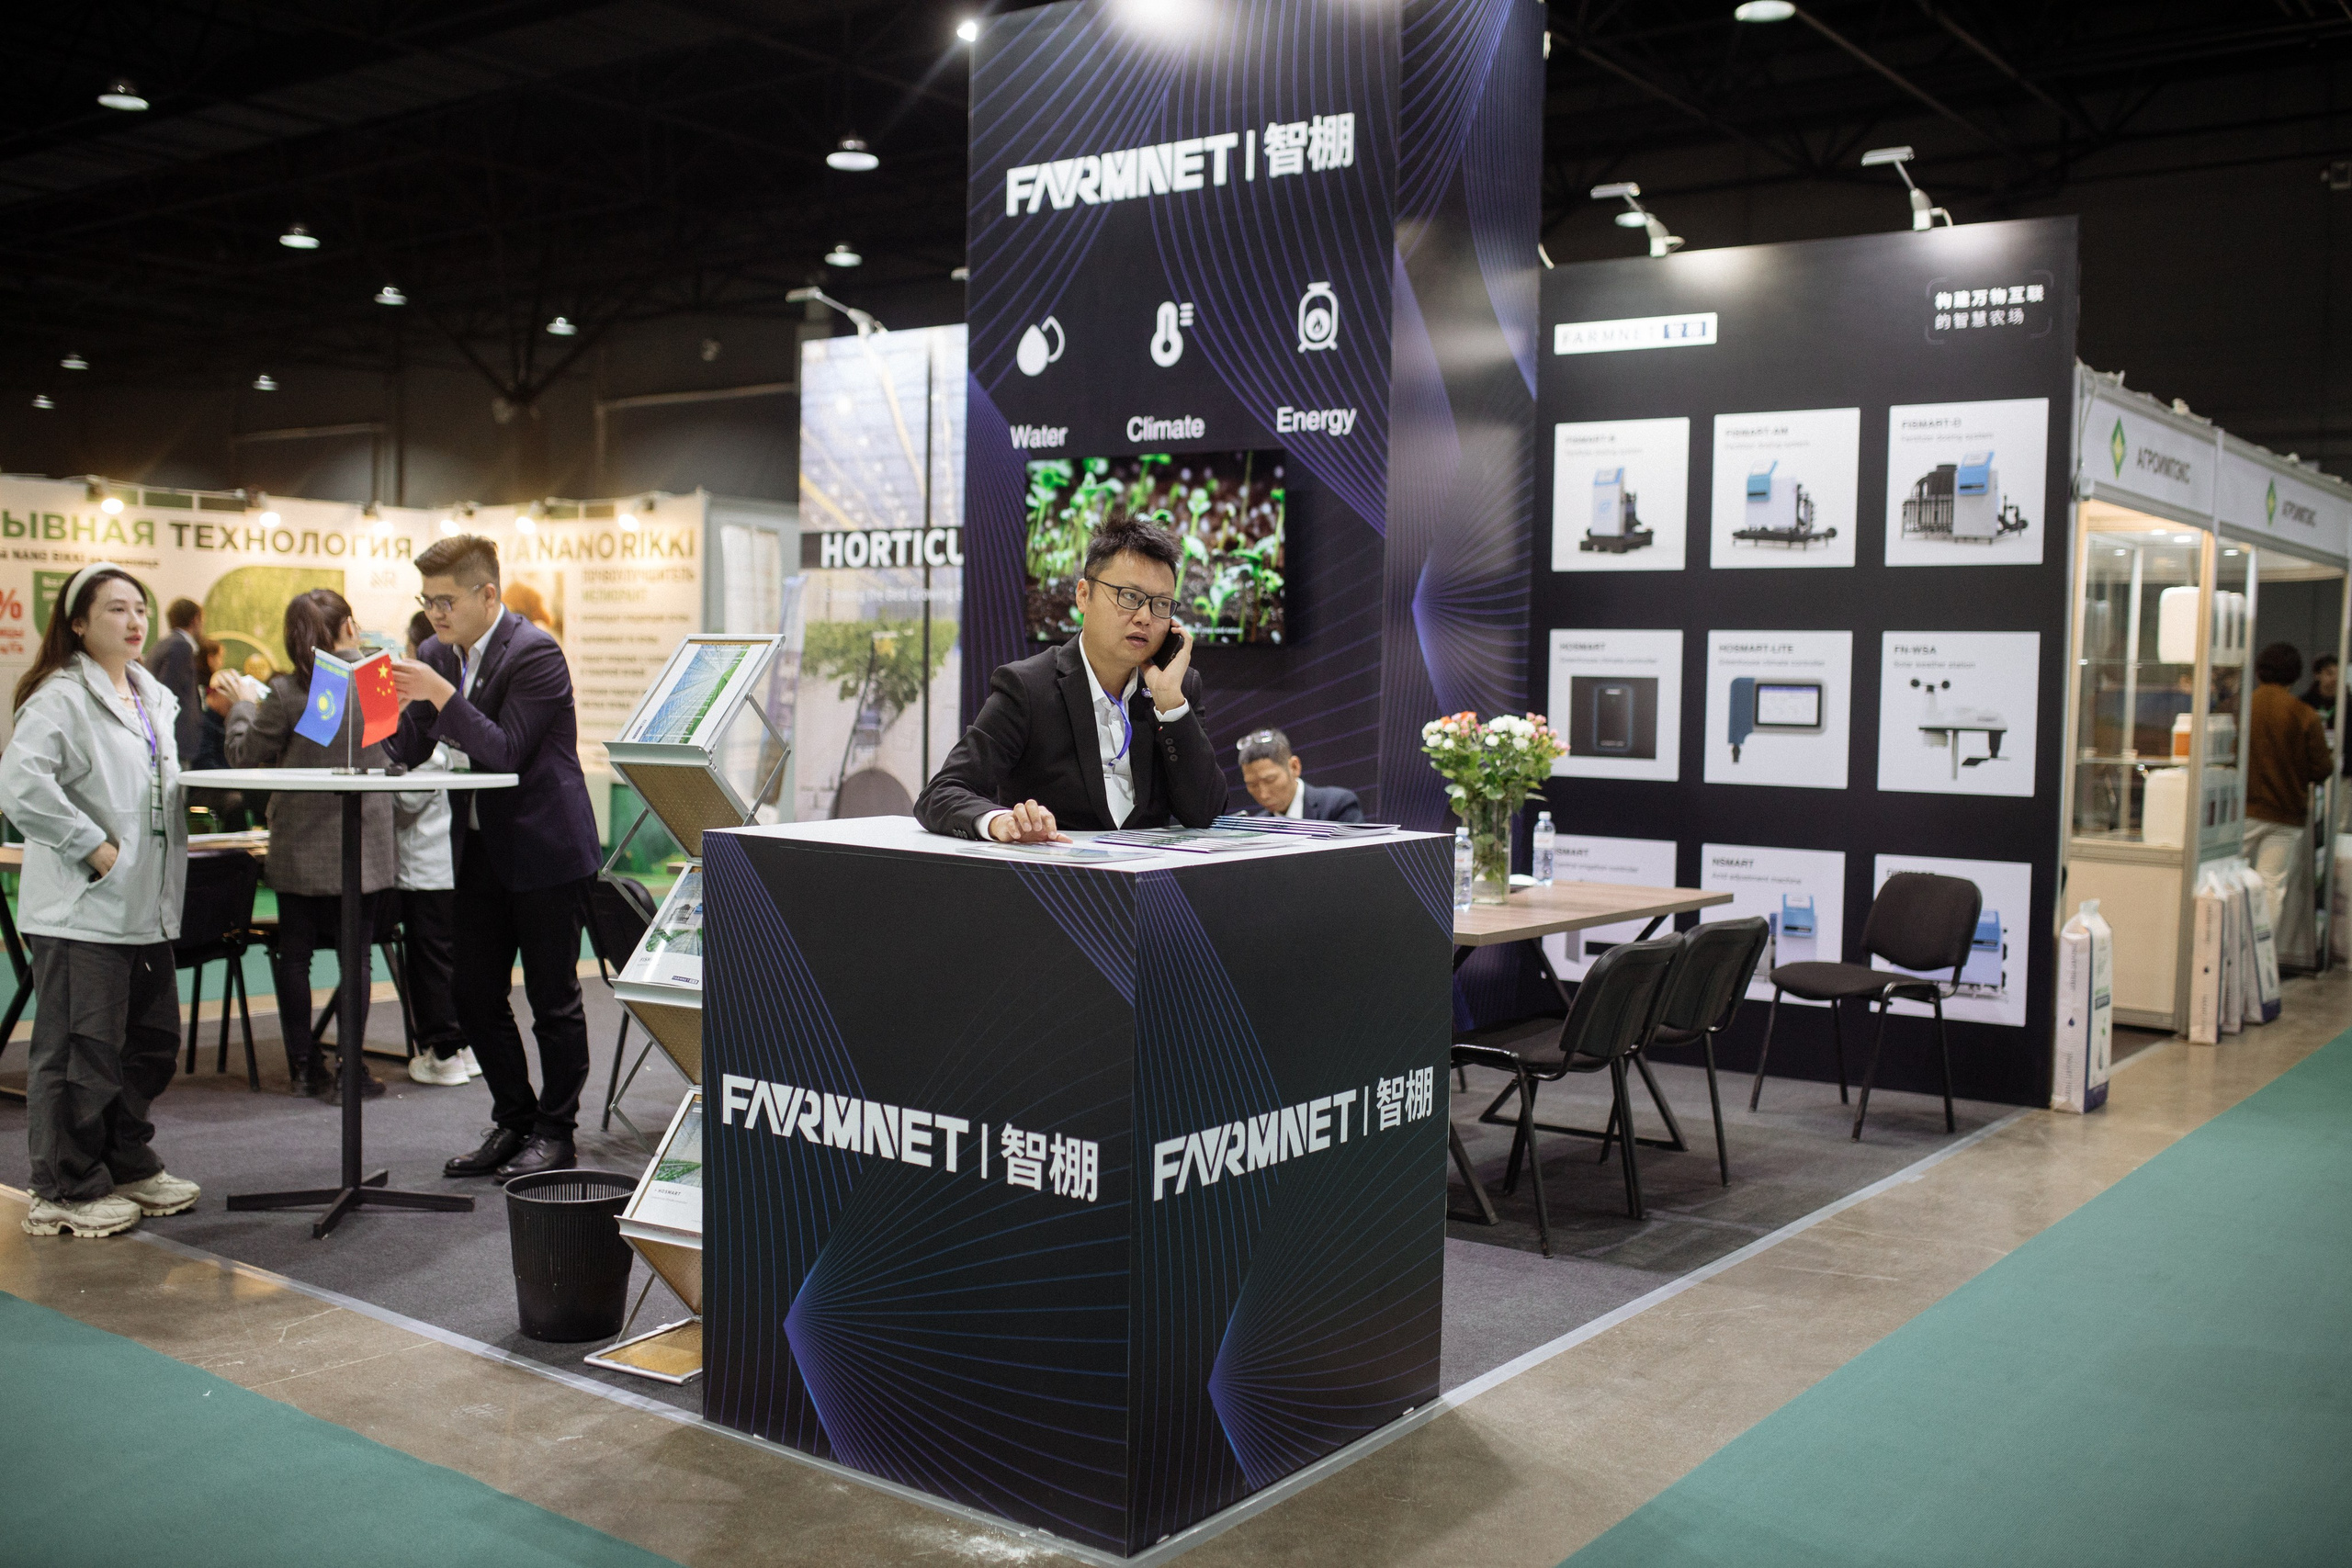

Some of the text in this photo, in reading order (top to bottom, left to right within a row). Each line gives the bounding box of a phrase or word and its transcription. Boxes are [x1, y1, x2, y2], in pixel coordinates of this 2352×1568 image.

[1006, 131, 1238, 217] FARMNET
[1263, 112, 1355, 178] 智棚
[1010, 424, 1069, 449] Water
[1126, 415, 1205, 443] Climate
[1275, 406, 1356, 435] Energy
[2, 511, 413, 558] ЫВНАЯ ТЕХНОЛОГИЯ
[721, 1073, 969, 1173] FARMNET
[1376, 1066, 1433, 1132] 智棚
[1001, 1122, 1099, 1202] 智棚
[1152, 1089, 1356, 1201] FARMNET
